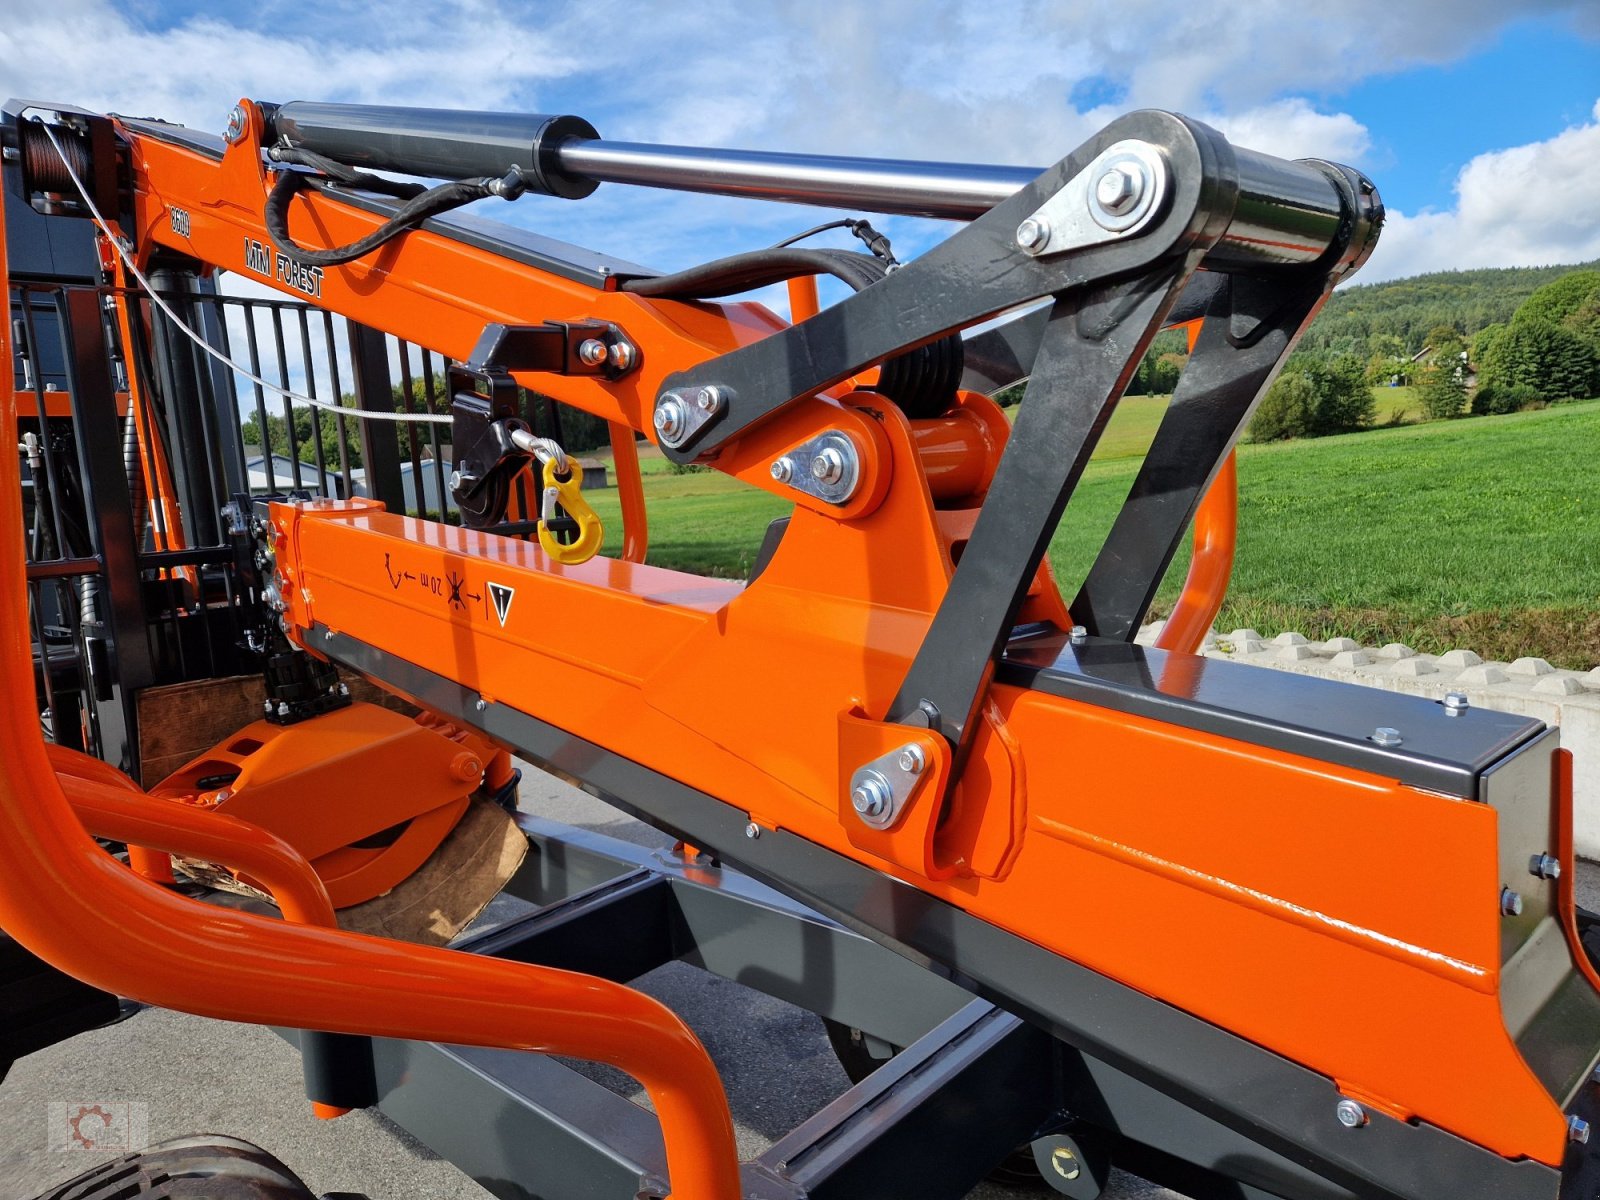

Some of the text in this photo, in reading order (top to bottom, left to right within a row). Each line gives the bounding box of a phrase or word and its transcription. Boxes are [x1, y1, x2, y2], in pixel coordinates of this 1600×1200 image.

[245, 237, 324, 298] MTM FOREST
[431, 576, 442, 596] 20
